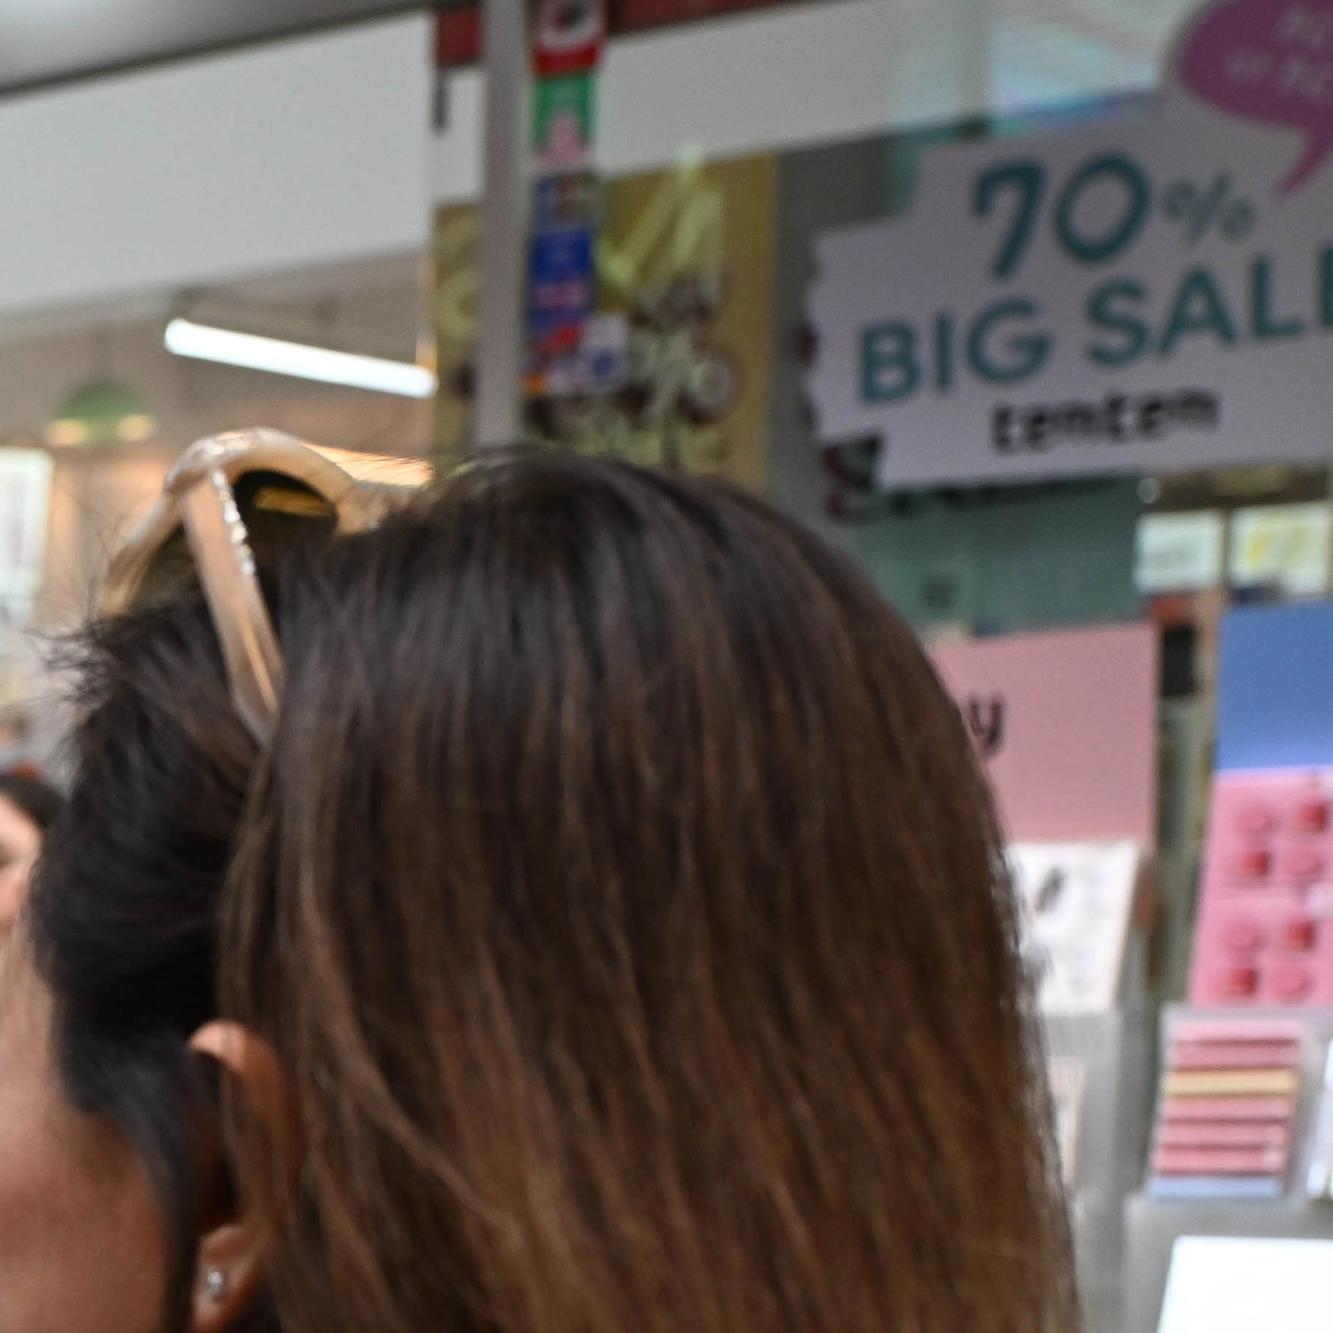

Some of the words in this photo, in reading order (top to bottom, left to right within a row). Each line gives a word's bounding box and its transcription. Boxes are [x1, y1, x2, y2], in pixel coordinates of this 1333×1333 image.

[974, 151, 1255, 283] 70%
[860, 298, 1050, 404] BIG
[991, 385, 1221, 455] tenten
